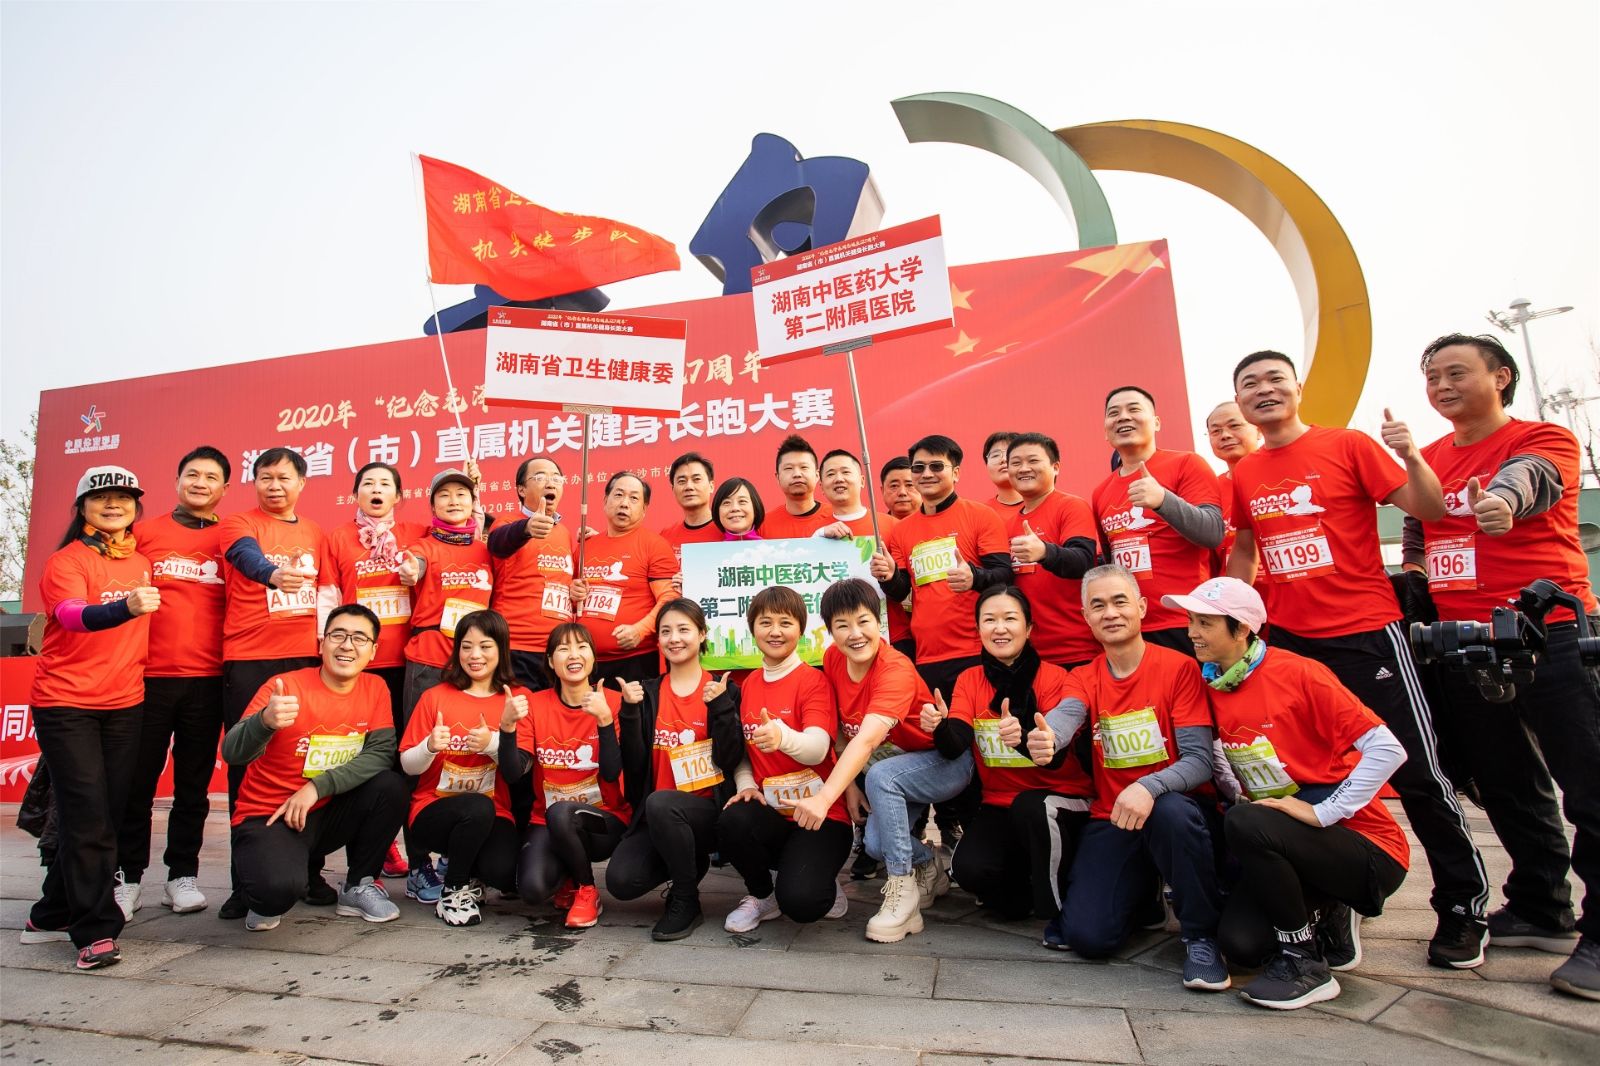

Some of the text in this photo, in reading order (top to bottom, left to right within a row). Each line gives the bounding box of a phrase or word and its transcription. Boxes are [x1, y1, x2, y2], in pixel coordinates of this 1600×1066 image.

[771, 255, 924, 315] 湖南中医药大学
[784, 289, 916, 341] 第二附属医院
[496, 351, 674, 385] 湖南省卫生健康委
[276, 400, 357, 433] 2020年
[164, 562, 199, 576] A1194
[914, 552, 952, 575] C1003
[1266, 543, 1320, 570] A1199
[717, 561, 849, 588] 湖南中医药大学
[1101, 729, 1155, 755] C1002
